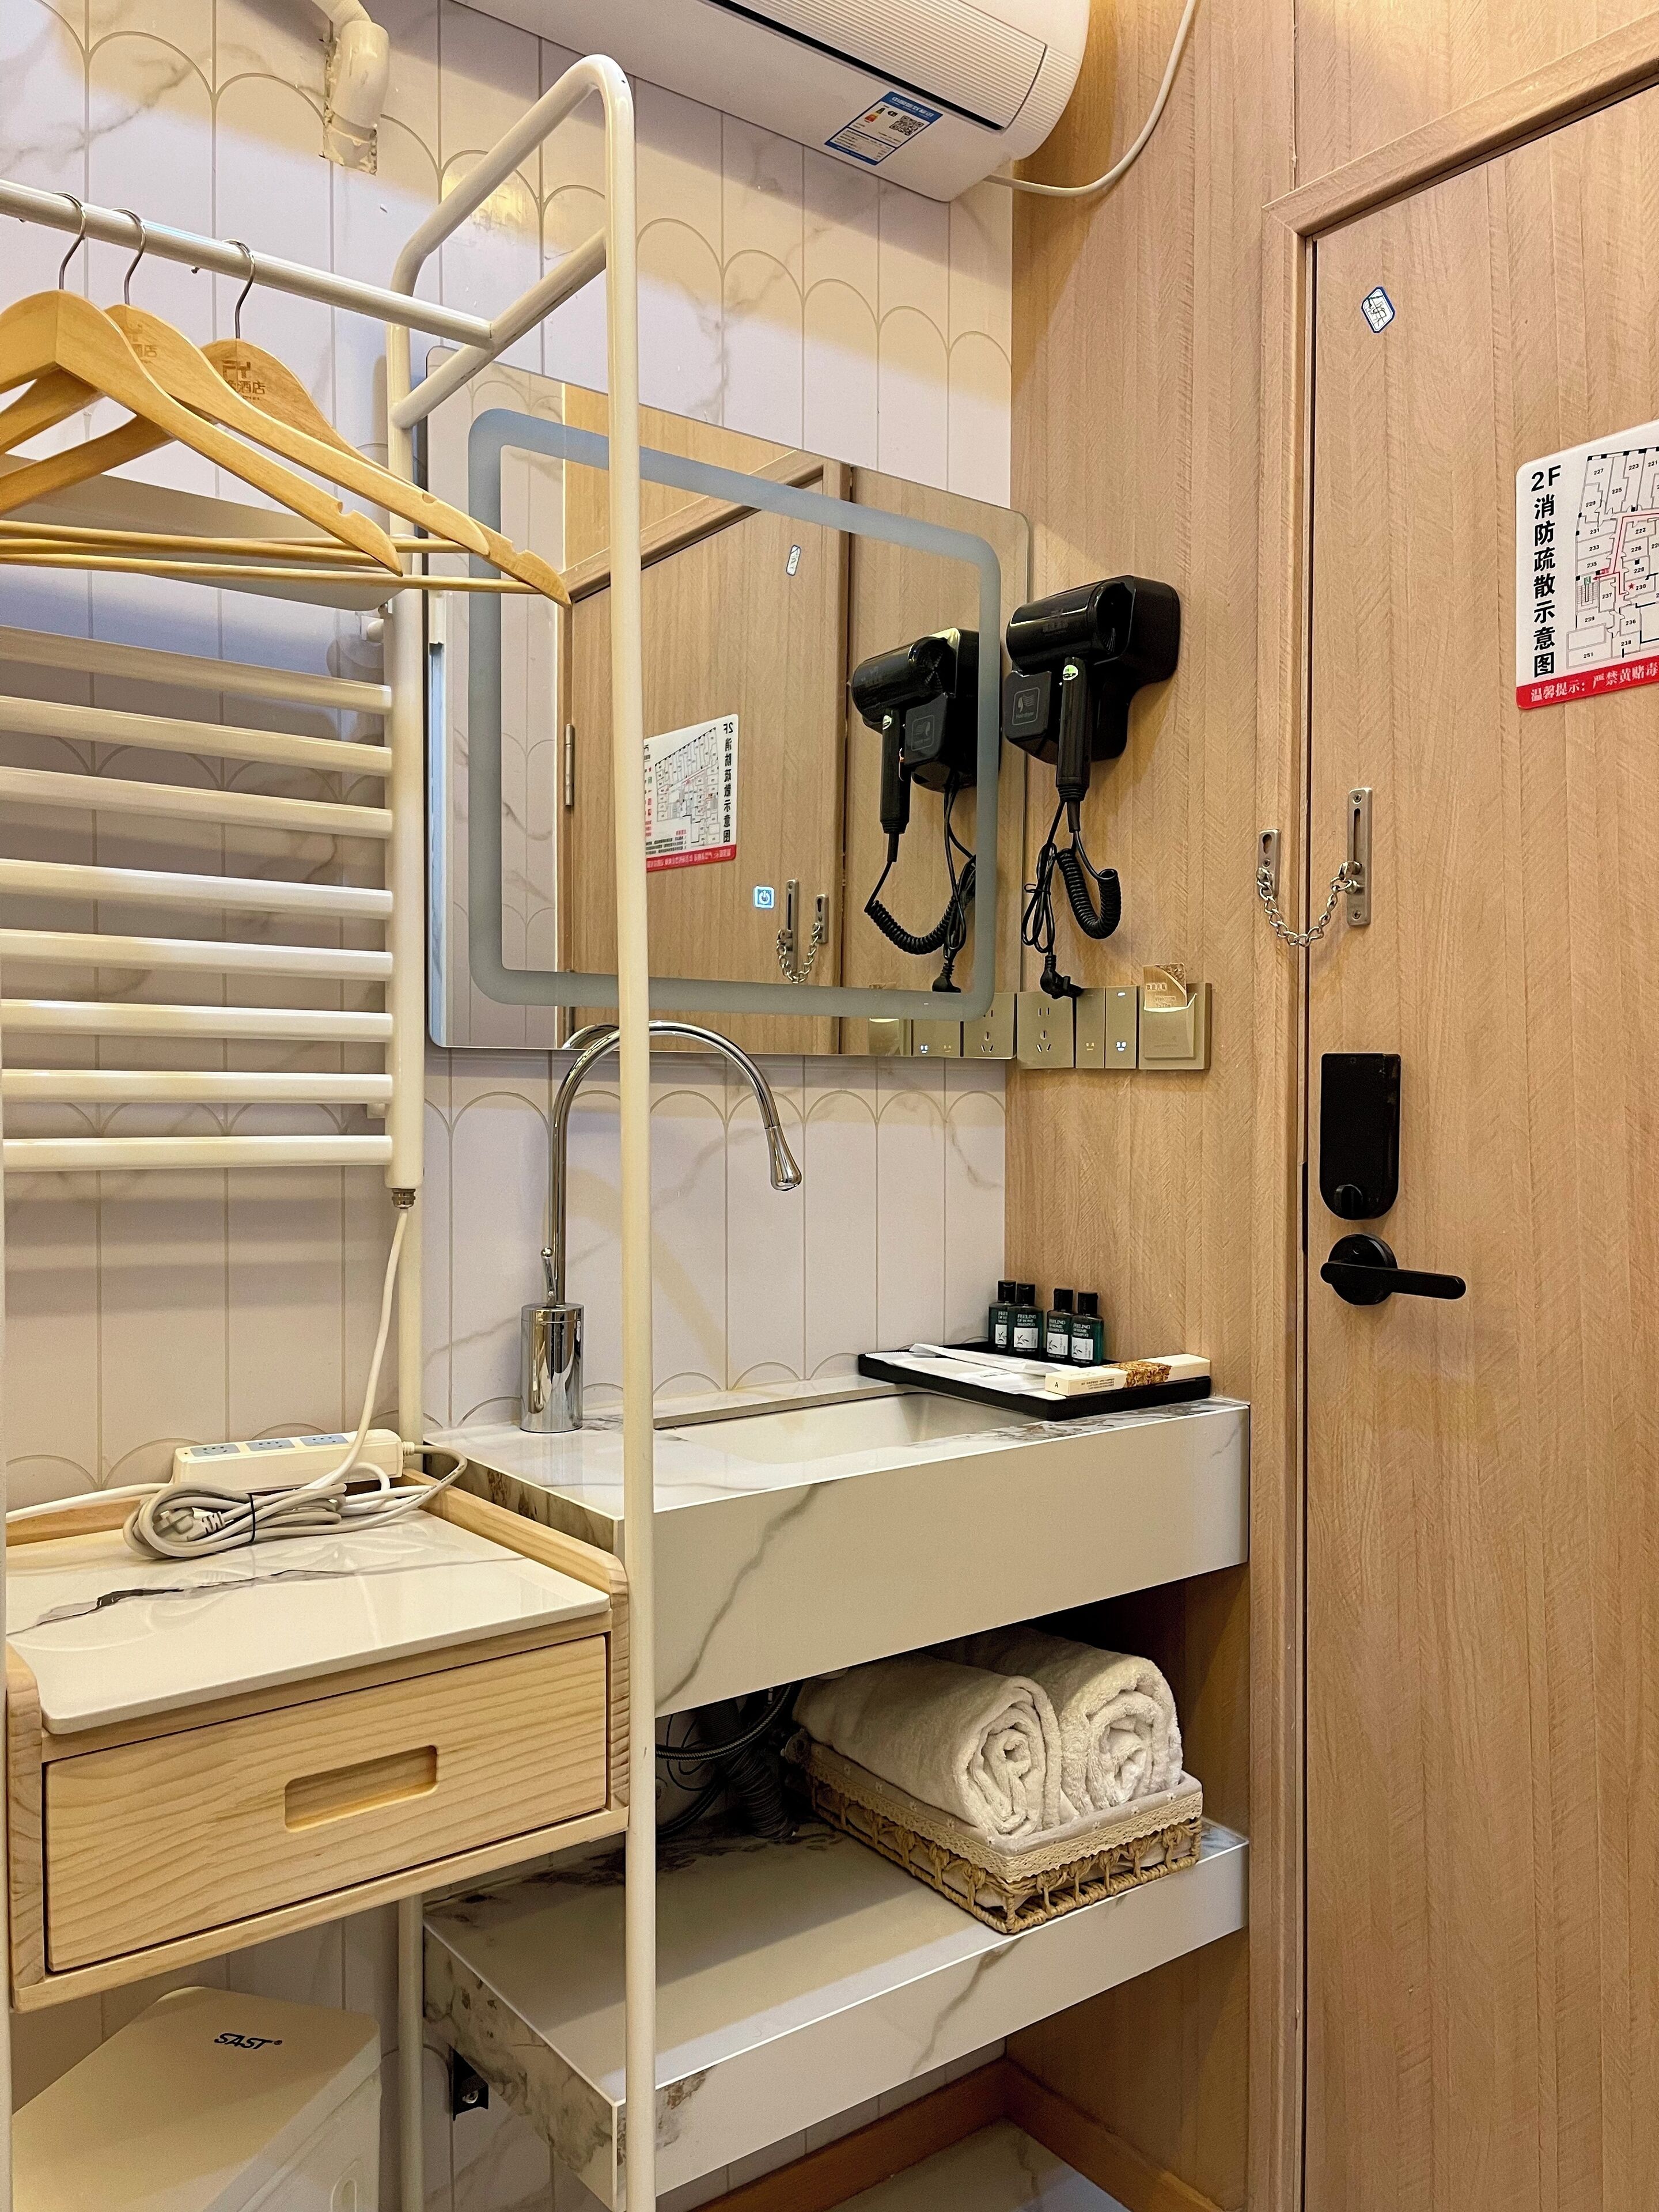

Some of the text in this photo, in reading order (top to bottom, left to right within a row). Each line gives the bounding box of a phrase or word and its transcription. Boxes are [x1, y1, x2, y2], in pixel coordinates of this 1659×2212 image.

[1531, 465, 1561, 491] 2F
[1533, 494, 1556, 677] 消防疏散示意图
[214, 2032, 273, 2050] SAST
